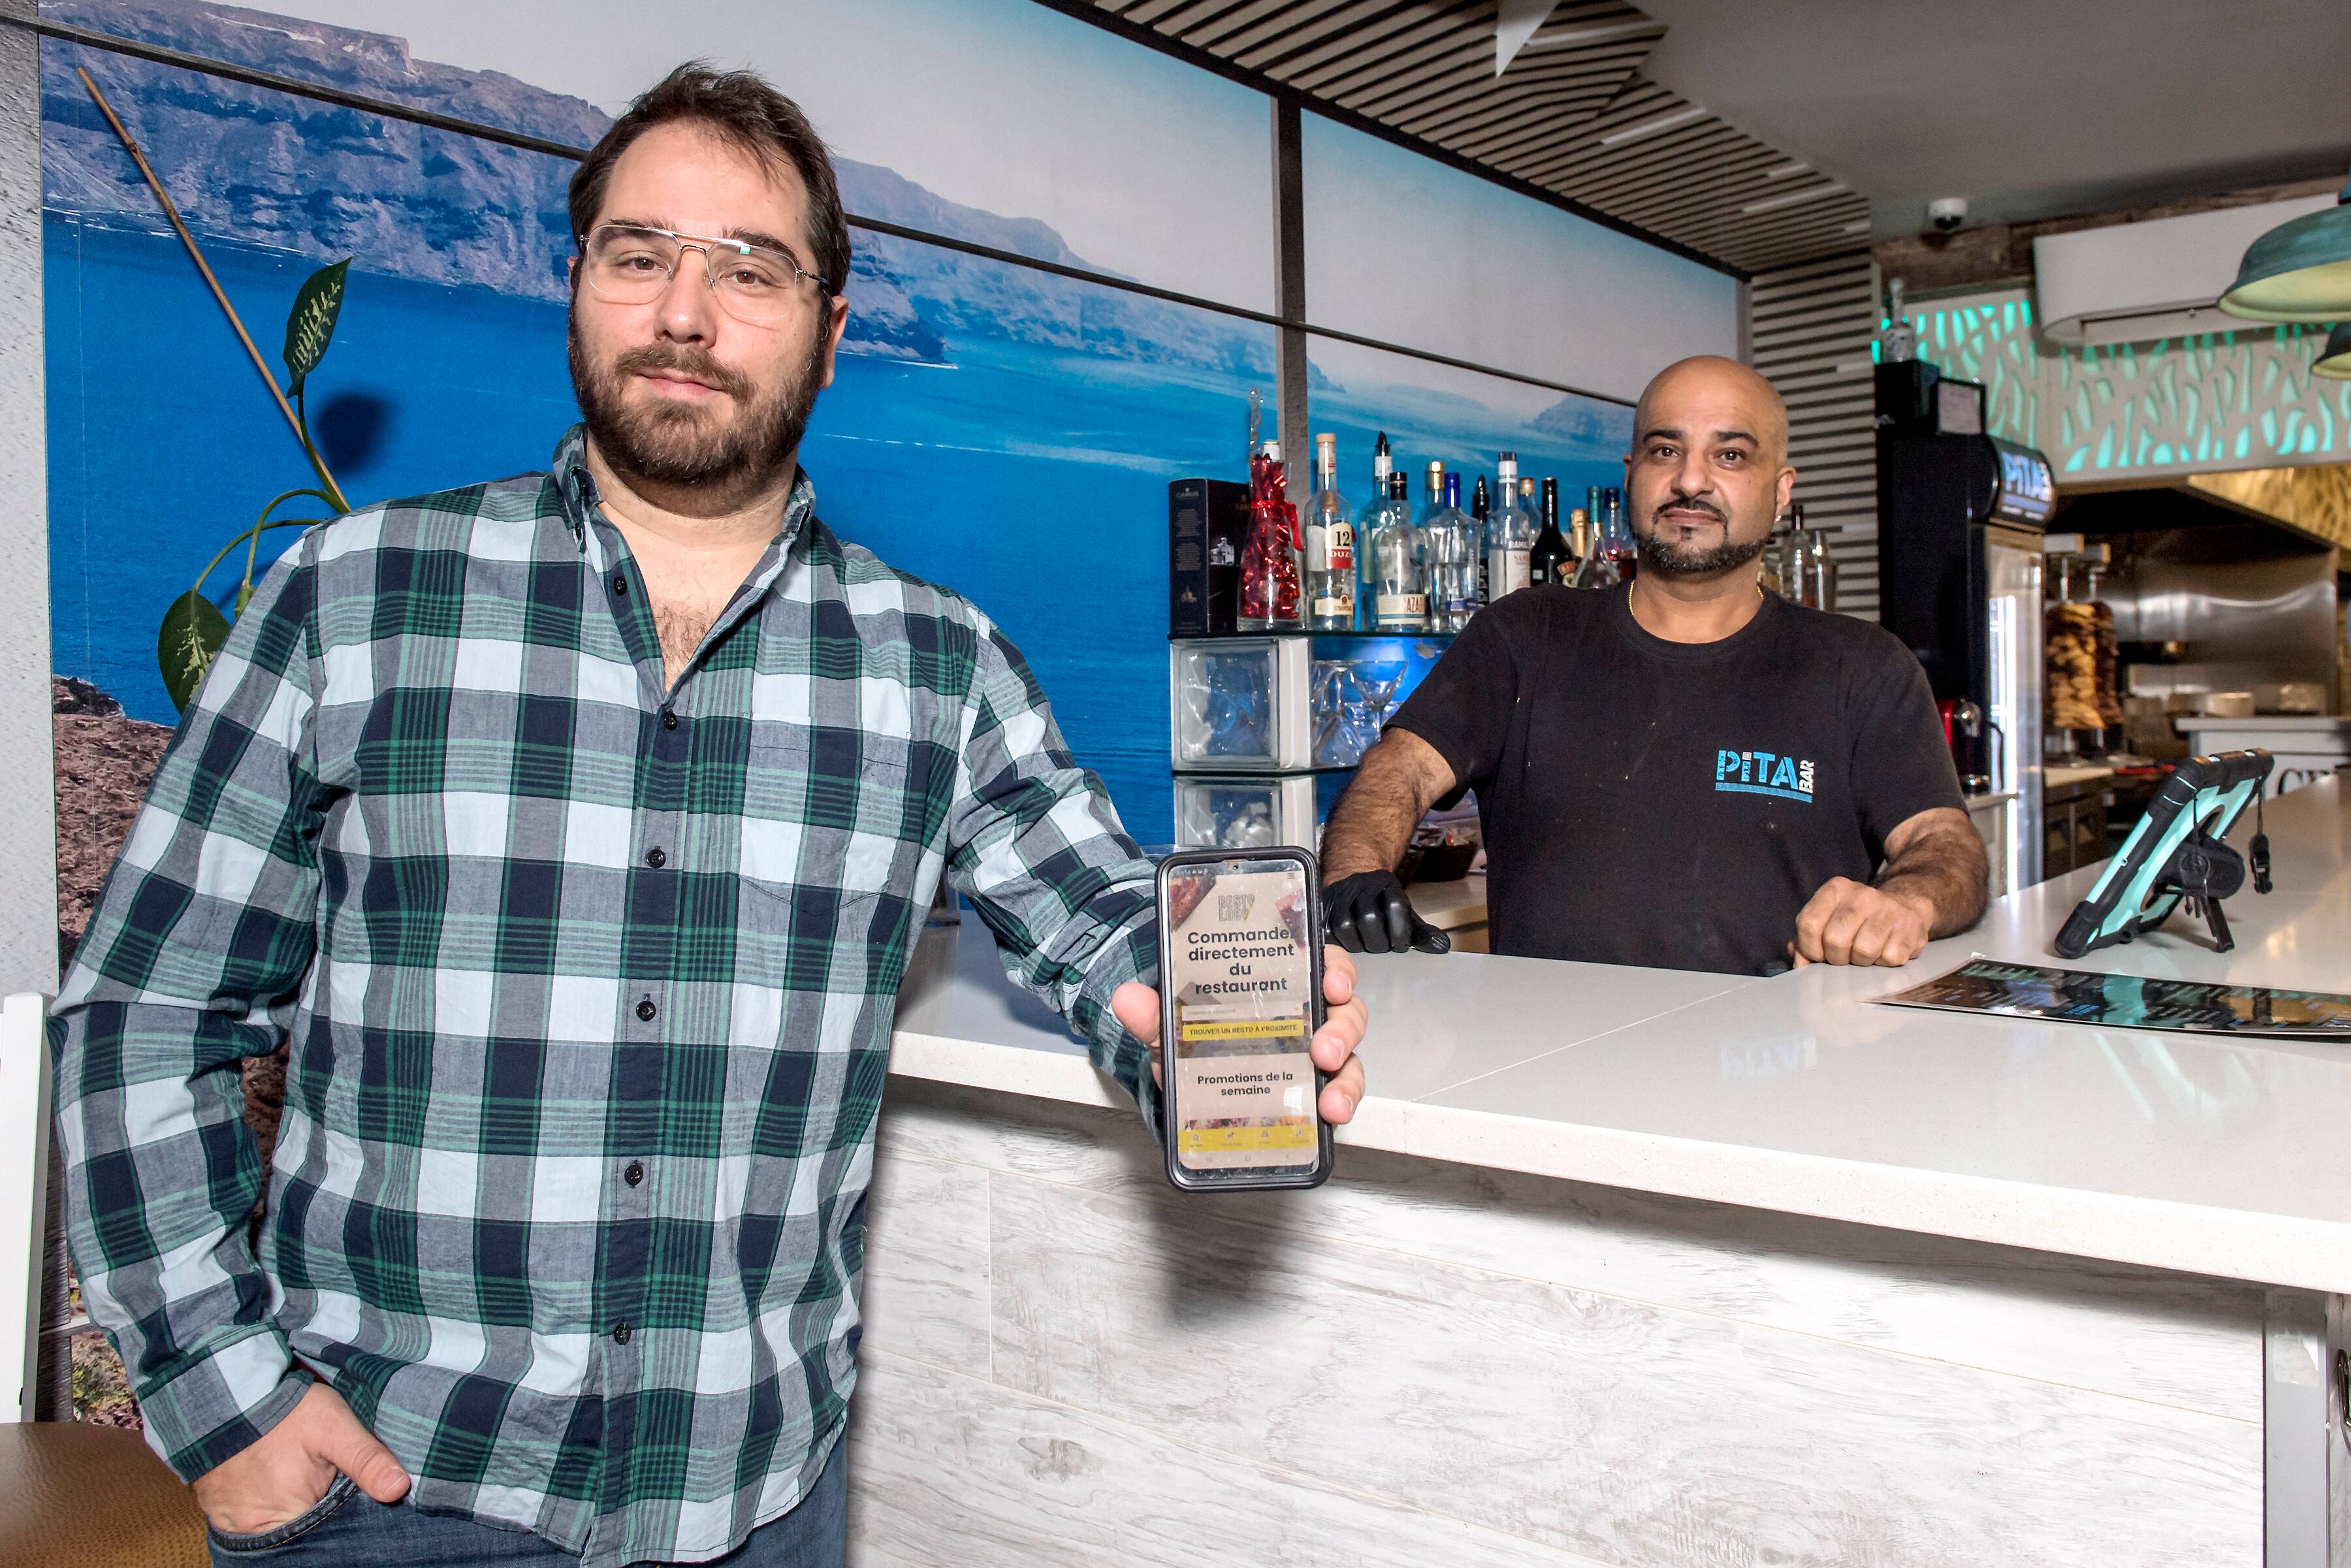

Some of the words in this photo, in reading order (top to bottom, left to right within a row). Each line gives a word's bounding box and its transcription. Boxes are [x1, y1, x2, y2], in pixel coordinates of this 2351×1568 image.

[1335, 531, 1350, 547] 12
[1799, 760, 1814, 793] BAR
[1219, 894, 1255, 908] RESTO
[1219, 908, 1249, 922] LOCO
[1189, 944, 1294, 961] directement
[1229, 963, 1251, 976] du
[1195, 978, 1287, 994] restaurant
[1197, 1073, 1263, 1085] Promotions
[1266, 1072, 1280, 1081] de
[1283, 1072, 1293, 1080] la
[1221, 1085, 1271, 1096] semaine
